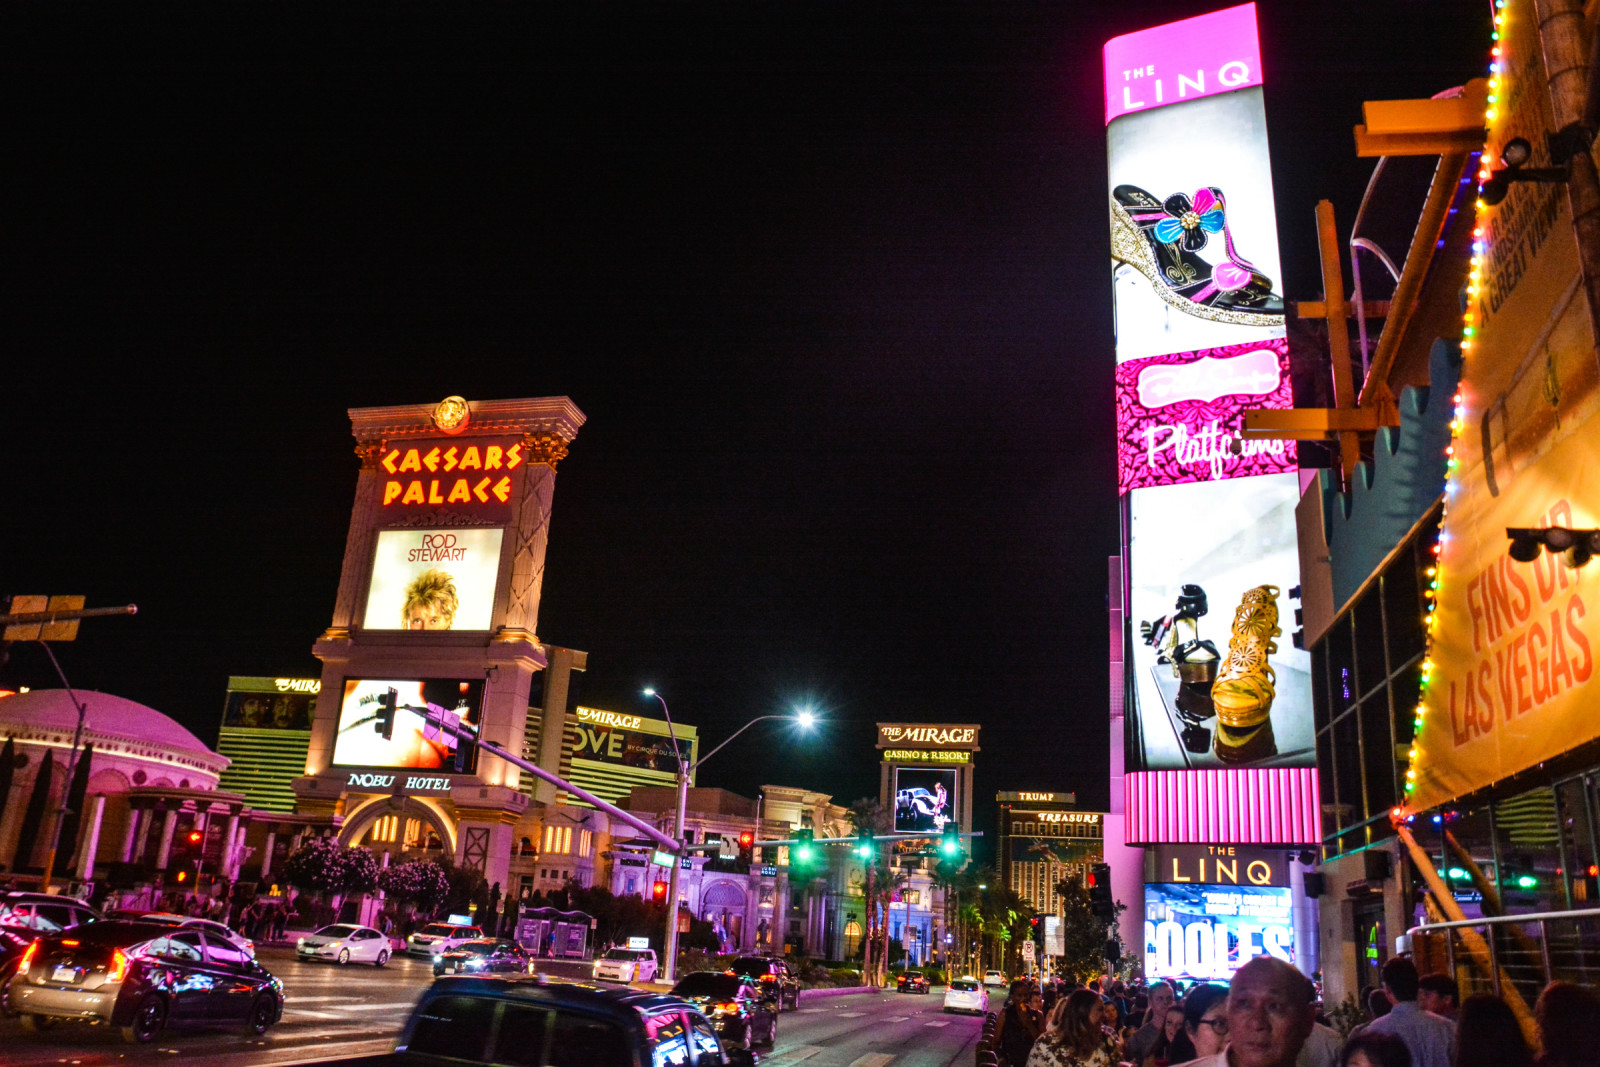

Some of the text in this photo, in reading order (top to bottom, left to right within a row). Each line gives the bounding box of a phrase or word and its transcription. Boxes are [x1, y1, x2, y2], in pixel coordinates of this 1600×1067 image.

[1123, 65, 1155, 81] THE
[1123, 61, 1250, 110] LINQ
[381, 443, 524, 475] CAESARS
[383, 475, 513, 506] PALACE
[421, 534, 457, 549] ROD
[407, 548, 468, 562] STEWART
[1466, 552, 1532, 655] FINS
[1449, 593, 1594, 748] LAS VEGAS
[578, 710, 641, 729] MIRAGE
[881, 727, 975, 744] THE MIRAGE
[884, 750, 971, 760] CASINO & RESORT
[347, 773, 452, 791] NOBU HOTEL
[1019, 792, 1054, 801] TRUMP
[1038, 813, 1098, 823] TREASURE
[1208, 846, 1236, 856] THE
[1172, 857, 1272, 885] LINQ
